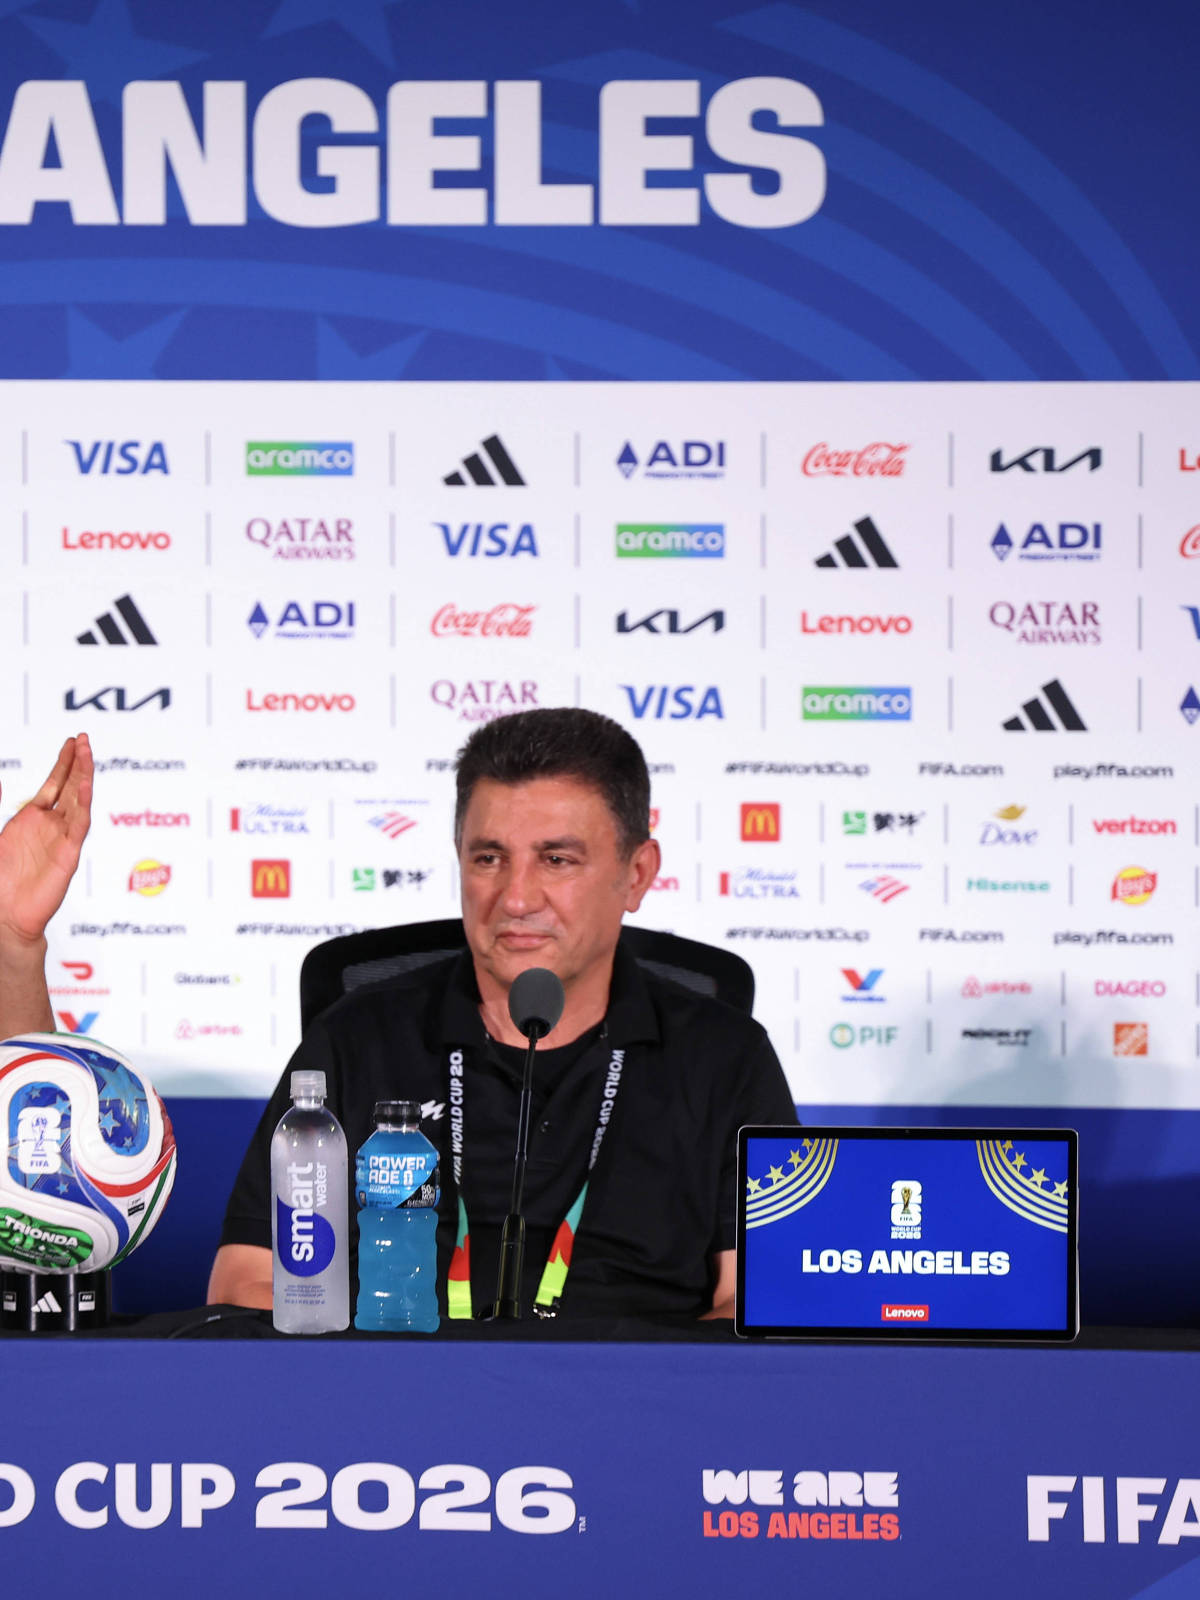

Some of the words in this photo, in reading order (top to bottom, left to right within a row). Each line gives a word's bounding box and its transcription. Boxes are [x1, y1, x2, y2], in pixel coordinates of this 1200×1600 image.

[68, 441, 169, 475] VISA
[247, 448, 353, 469] aramco
[647, 441, 725, 467] ADI
[62, 527, 171, 550] Lenovo
[245, 518, 354, 546] QATAR
[437, 523, 538, 557] VISA
[618, 530, 723, 552] aramco
[1022, 523, 1101, 549] ADI
[273, 545, 355, 561] AIRWAYS
[277, 602, 354, 627] ADI
[801, 611, 913, 634] Lenovo
[990, 602, 1099, 630] QATAR
[1017, 629, 1101, 645] AIRWAYS
[246, 689, 356, 712] Lenovo
[430, 680, 539, 708] QATAR
[619, 685, 724, 719] VISA
[804, 692, 910, 714] aramco
[94, 757, 186, 773] y.fifa.com
[235, 759, 377, 773] #FIFAWorldCup
[725, 762, 869, 777] #FIFAWorldCup
[919, 763, 1004, 776] FIFA.com
[1054, 763, 1173, 779] play.fifa.com
[110, 810, 190, 827] verizon
[1093, 816, 1177, 835] verizon
[967, 878, 1050, 892] Hisense
[70, 922, 186, 937] play.fifa.com
[725, 927, 869, 943] #FIFAWorldCup
[919, 929, 1004, 942] FIFA.com
[1054, 930, 1173, 946] play.fifa.com
[1094, 980, 1166, 997] DIAGEO
[859, 1026, 898, 1046] PIF
[604, 1050, 625, 1098] WORLD
[451, 1078, 464, 1105] CUP
[599, 1099, 614, 1125] CUP
[451, 1106, 464, 1153] WORLD
[30, 1160, 49, 1168] FIFA
[369, 1155, 426, 1171] POWER
[316, 1162, 329, 1207] water
[368, 1169, 400, 1184] ADE
[286, 1162, 315, 1263] smart
[5, 1215, 79, 1248] TRIONDA
[802, 1250, 862, 1273] LOS
[867, 1251, 1010, 1275] ANGELES
[885, 1308, 925, 1318] Lenovo
[55, 1462, 235, 1529] CUP
[255, 1463, 577, 1534] 2026
[703, 1470, 783, 1505] WE
[794, 1471, 898, 1507] ARE
[1027, 1475, 1200, 1544] FIFA
[703, 1511, 759, 1538] LOS
[767, 1512, 901, 1540] ANGELES
